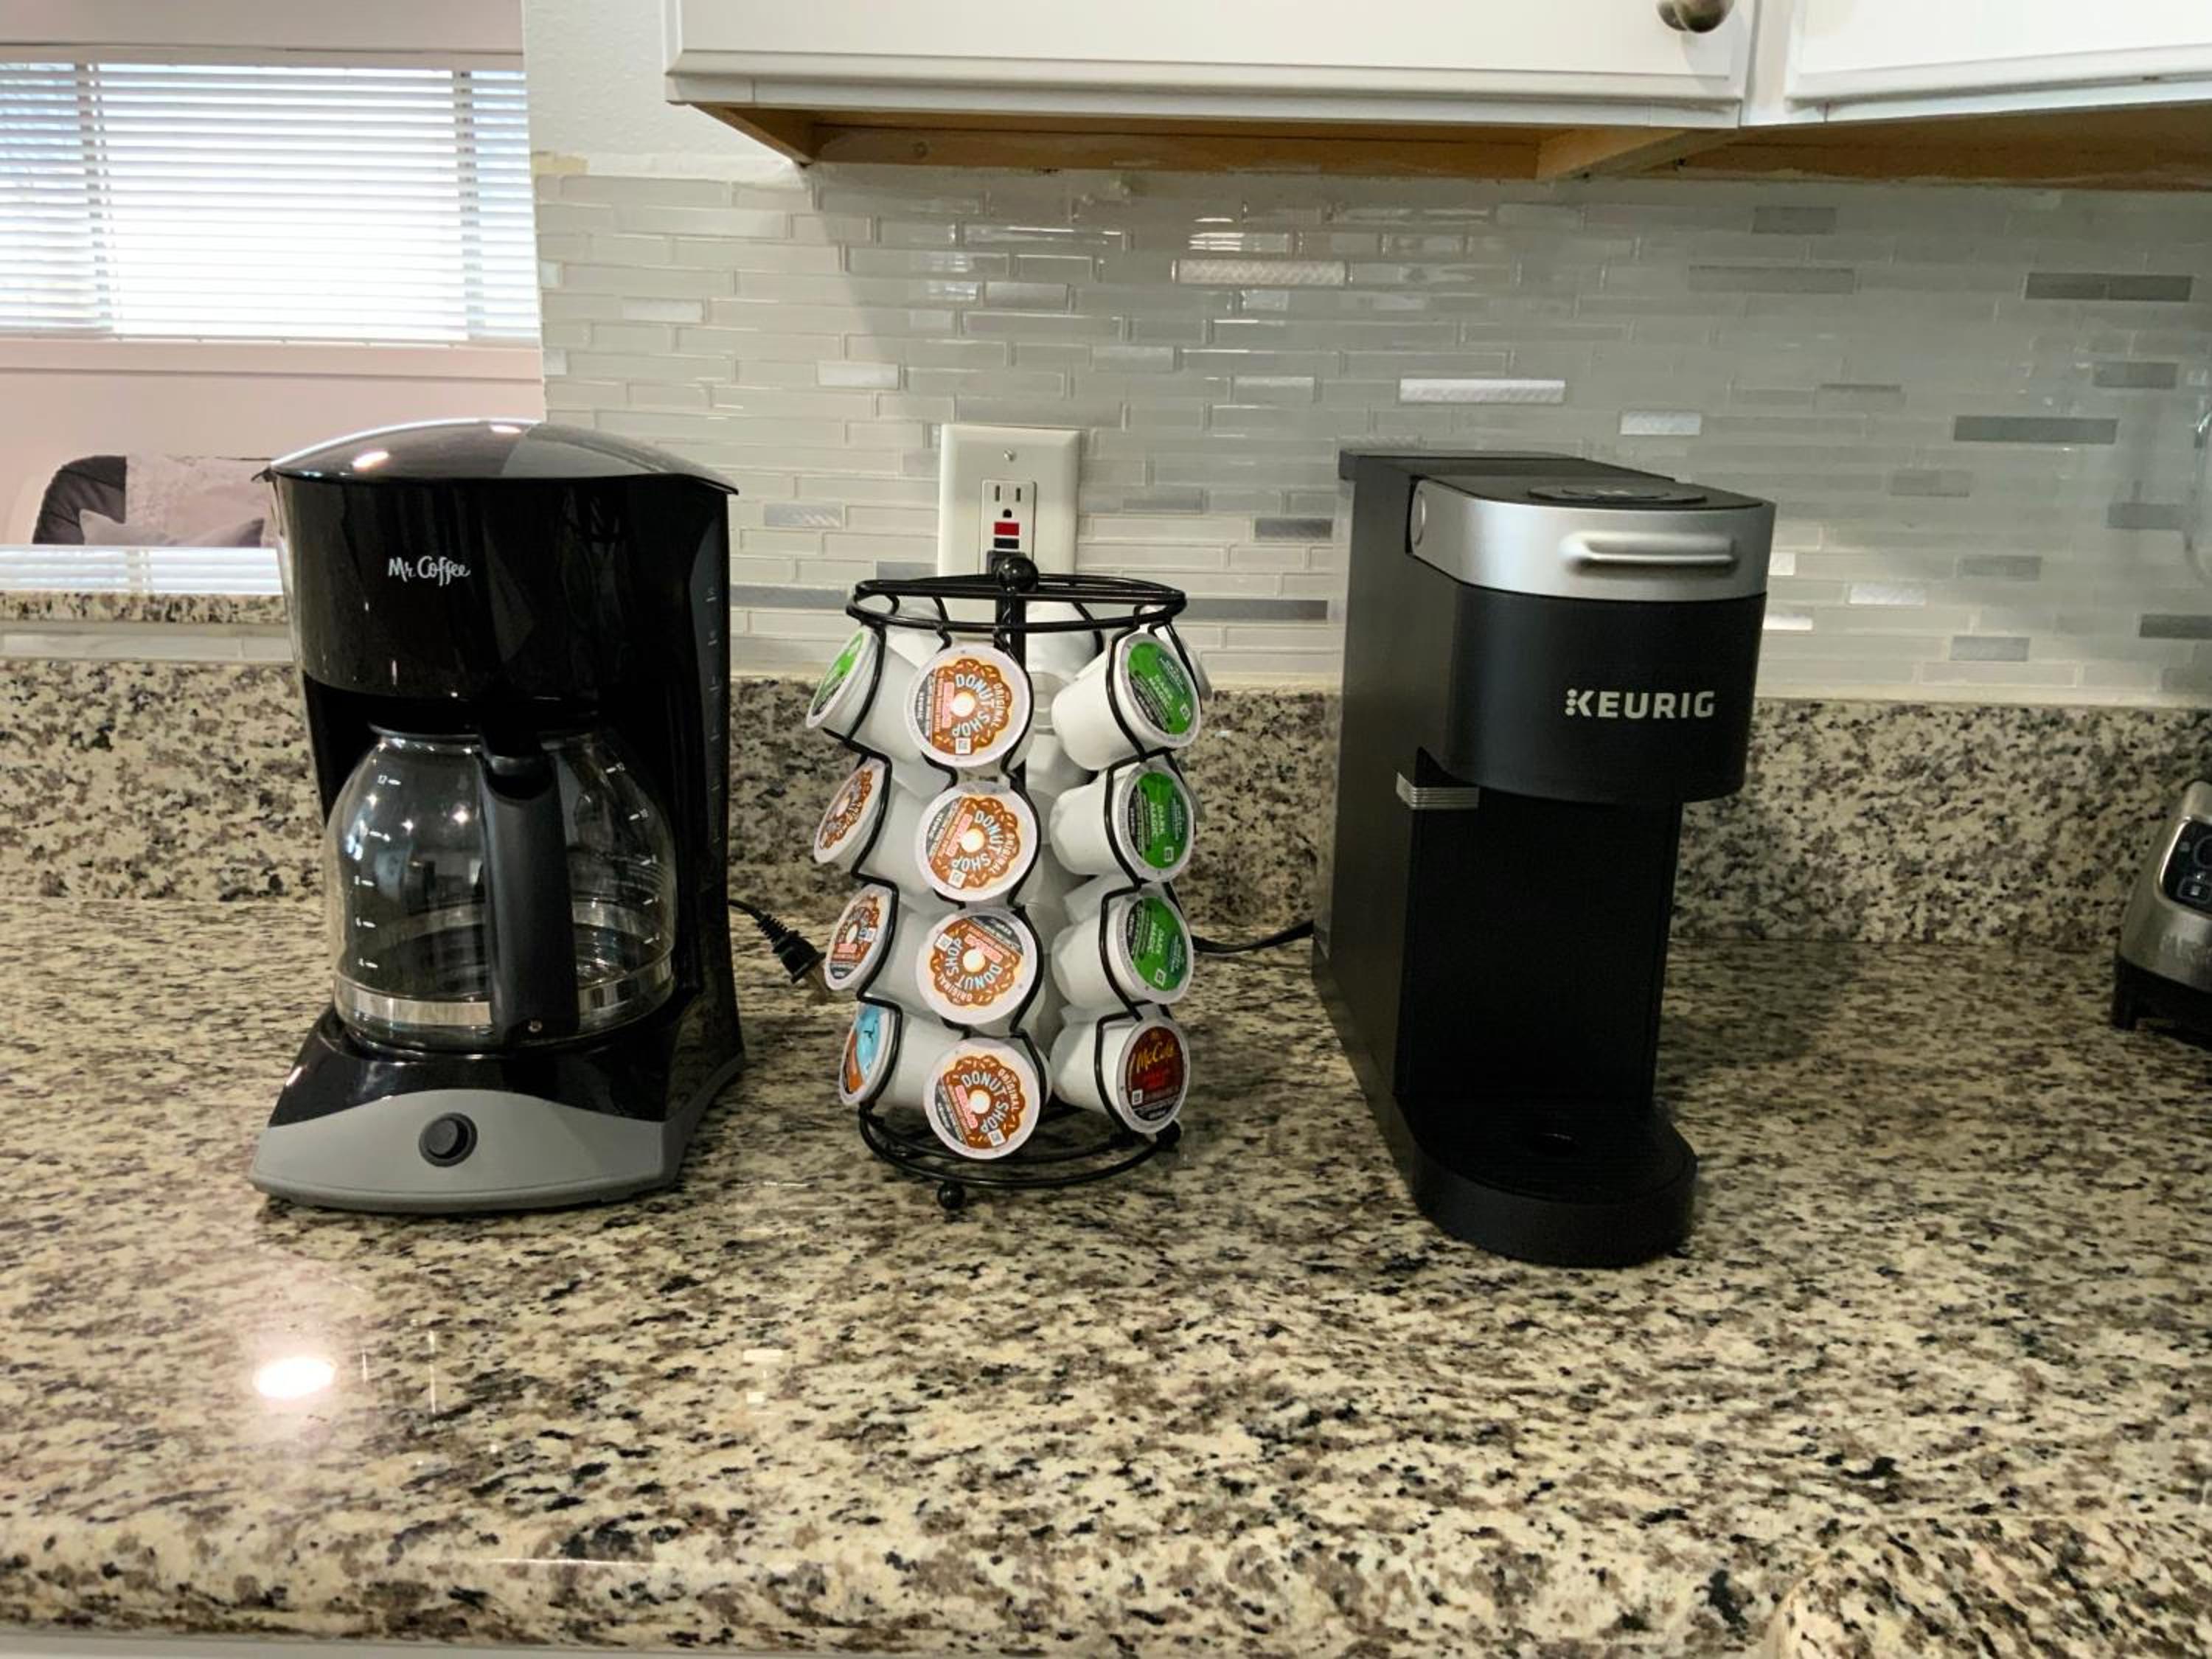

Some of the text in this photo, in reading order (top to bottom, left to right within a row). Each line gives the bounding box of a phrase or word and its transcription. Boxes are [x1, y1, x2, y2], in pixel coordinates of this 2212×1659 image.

[417, 555, 471, 587] Coffee
[952, 673, 995, 737] DONUT SHOP
[1565, 688, 1715, 719] KEURIG
[974, 810, 1004, 855] DONUT
[951, 852, 992, 872] SHOP
[944, 937, 963, 977] SHOP
[954, 962, 1004, 990] DONUT
[961, 1071, 1008, 1096] DONUT
[980, 1100, 1009, 1133] SHOP
